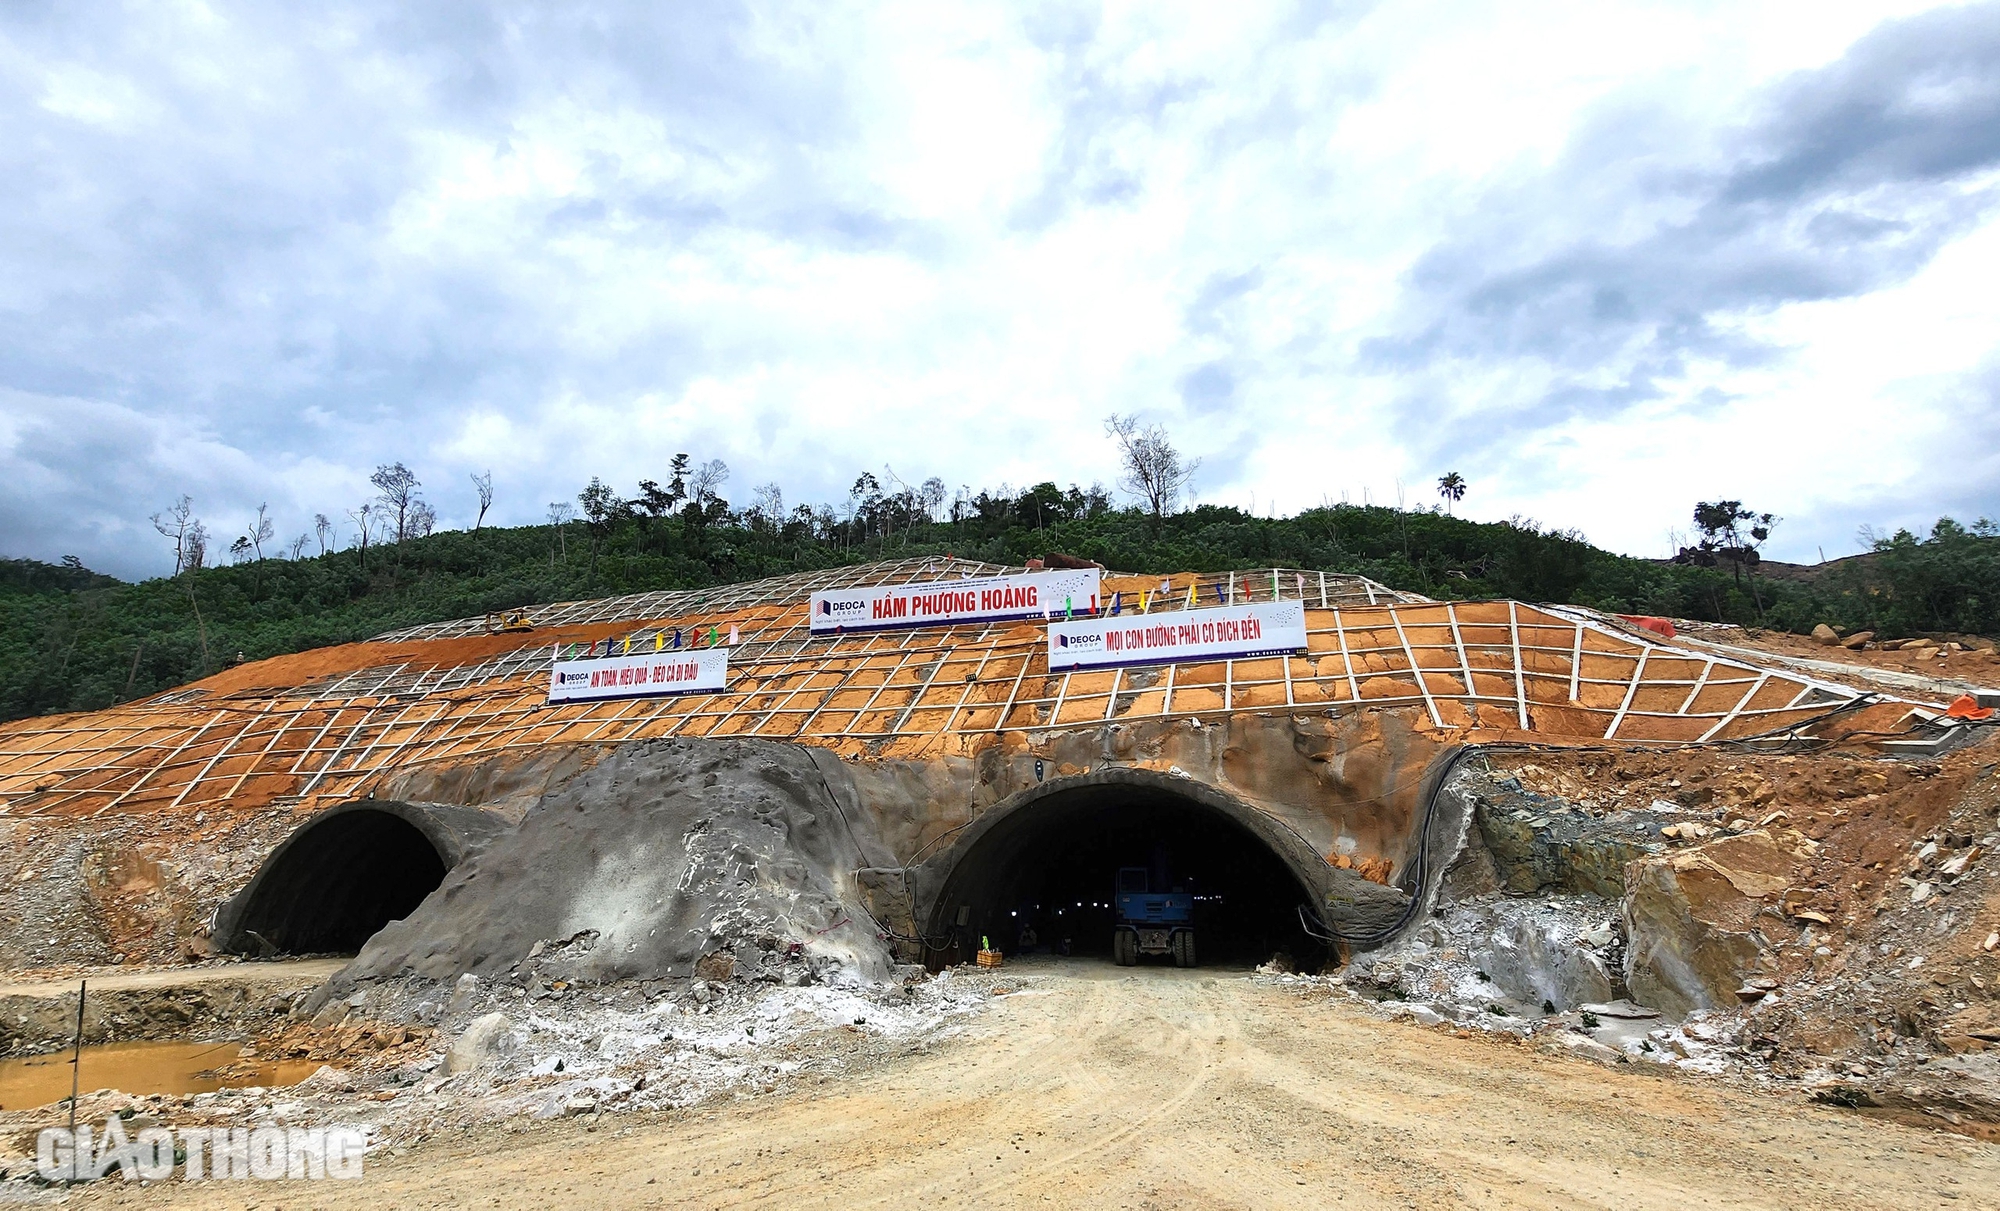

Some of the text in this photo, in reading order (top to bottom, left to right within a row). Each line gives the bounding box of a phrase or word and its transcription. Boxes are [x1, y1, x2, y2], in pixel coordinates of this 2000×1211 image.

[833, 600, 866, 611] DEOCA
[872, 591, 907, 619] HẦM
[912, 591, 976, 618] PHƯỢNG
[981, 584, 1038, 610] HOÀNG
[1070, 634, 1102, 644] DEOCA
[1106, 612, 1261, 655] MỌI CON ĐƯỜNG PHẢI CÓ ĐÍCH ĐẾN
[566, 672, 589, 682] DEOCA
[590, 671, 600, 688] AN
